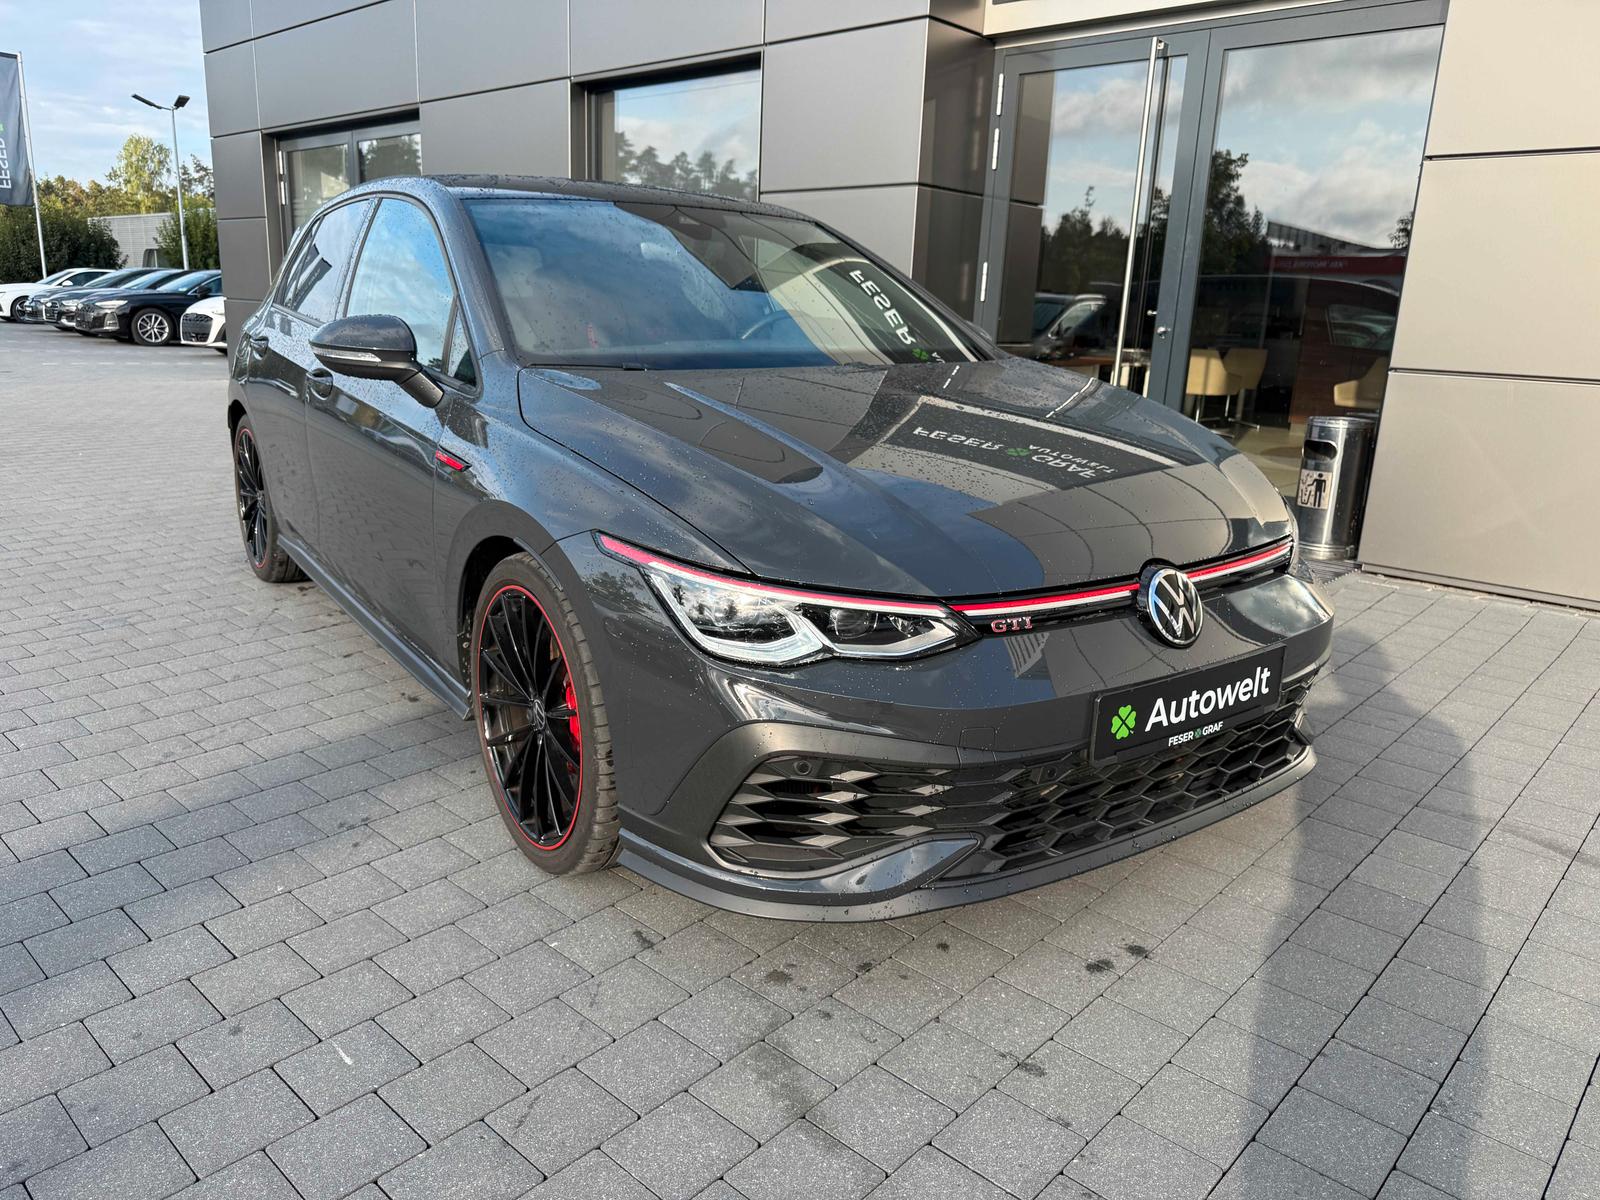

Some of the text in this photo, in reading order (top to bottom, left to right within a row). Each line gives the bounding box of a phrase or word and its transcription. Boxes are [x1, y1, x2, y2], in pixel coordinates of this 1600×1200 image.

[990, 616, 1034, 633] GTI
[1144, 666, 1271, 732] Autowelt
[1168, 721, 1224, 747] FESER GRAF
